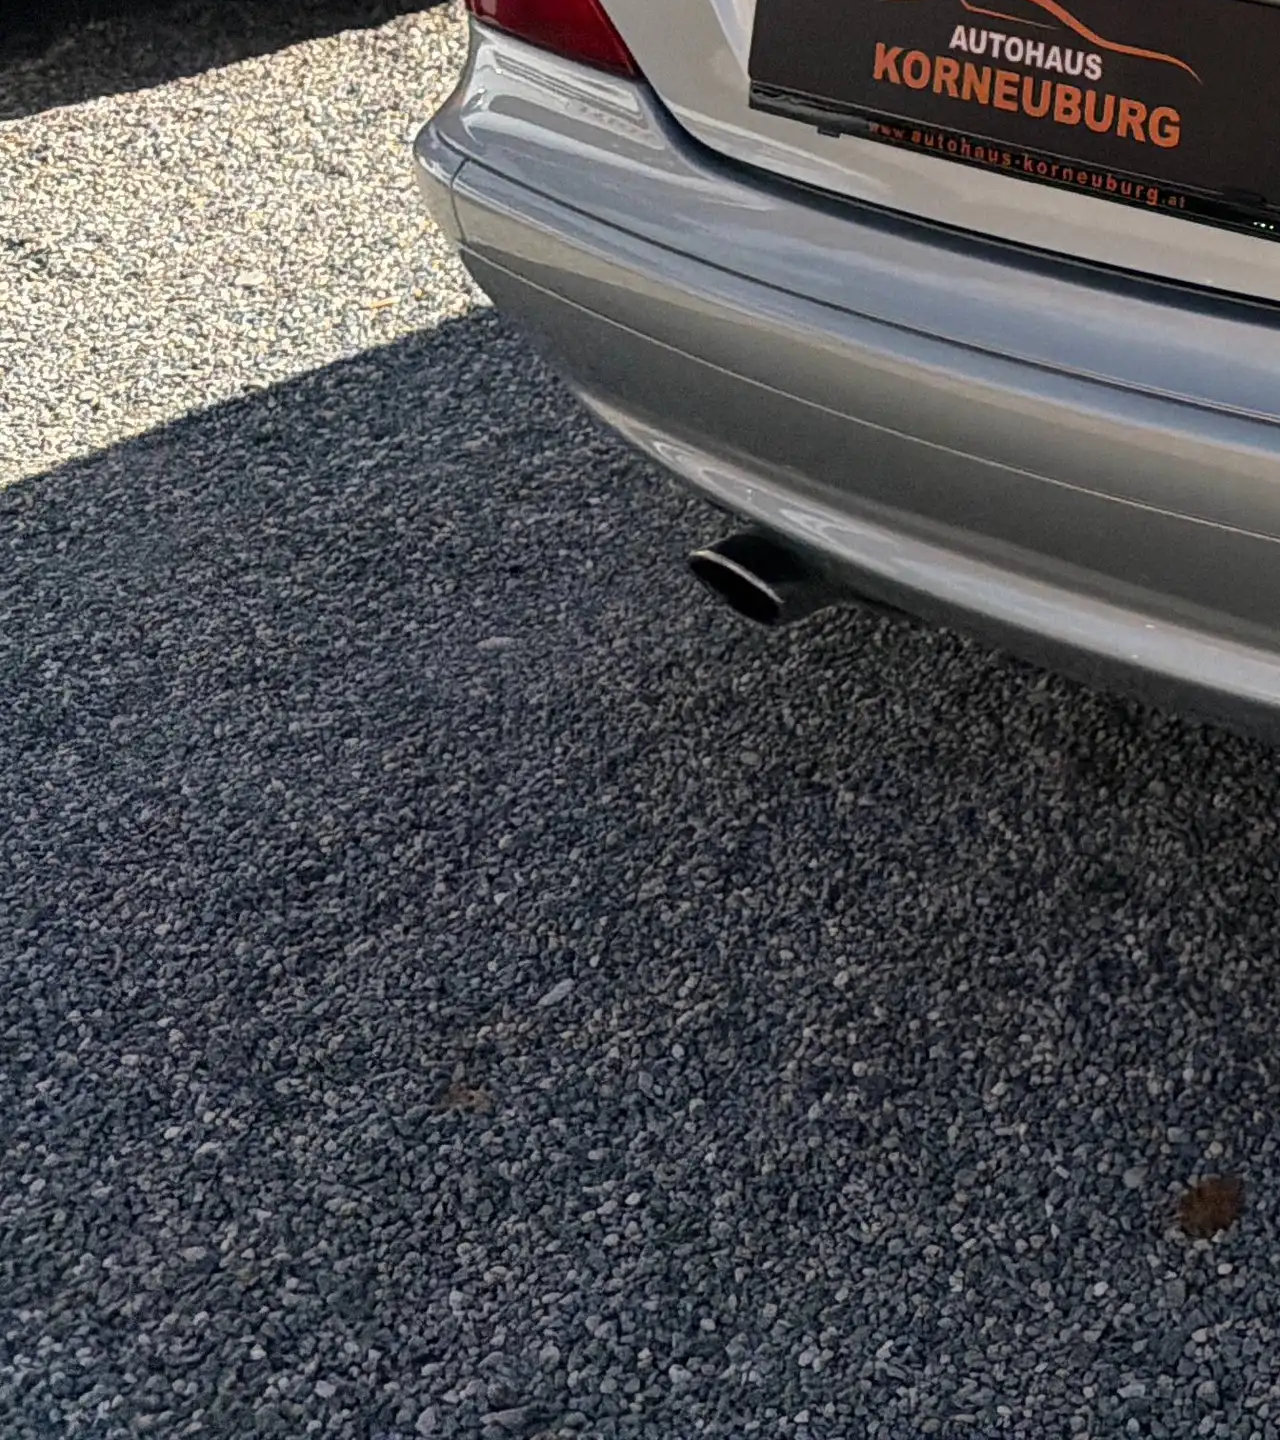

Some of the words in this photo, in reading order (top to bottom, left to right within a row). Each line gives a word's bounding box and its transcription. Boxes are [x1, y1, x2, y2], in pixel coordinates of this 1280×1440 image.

[872, 41, 1182, 149] KORNEUBURG
[949, 24, 1104, 81] AUTOHAUS
[866, 120, 1188, 210] www.autohaus-korneuburg.at
